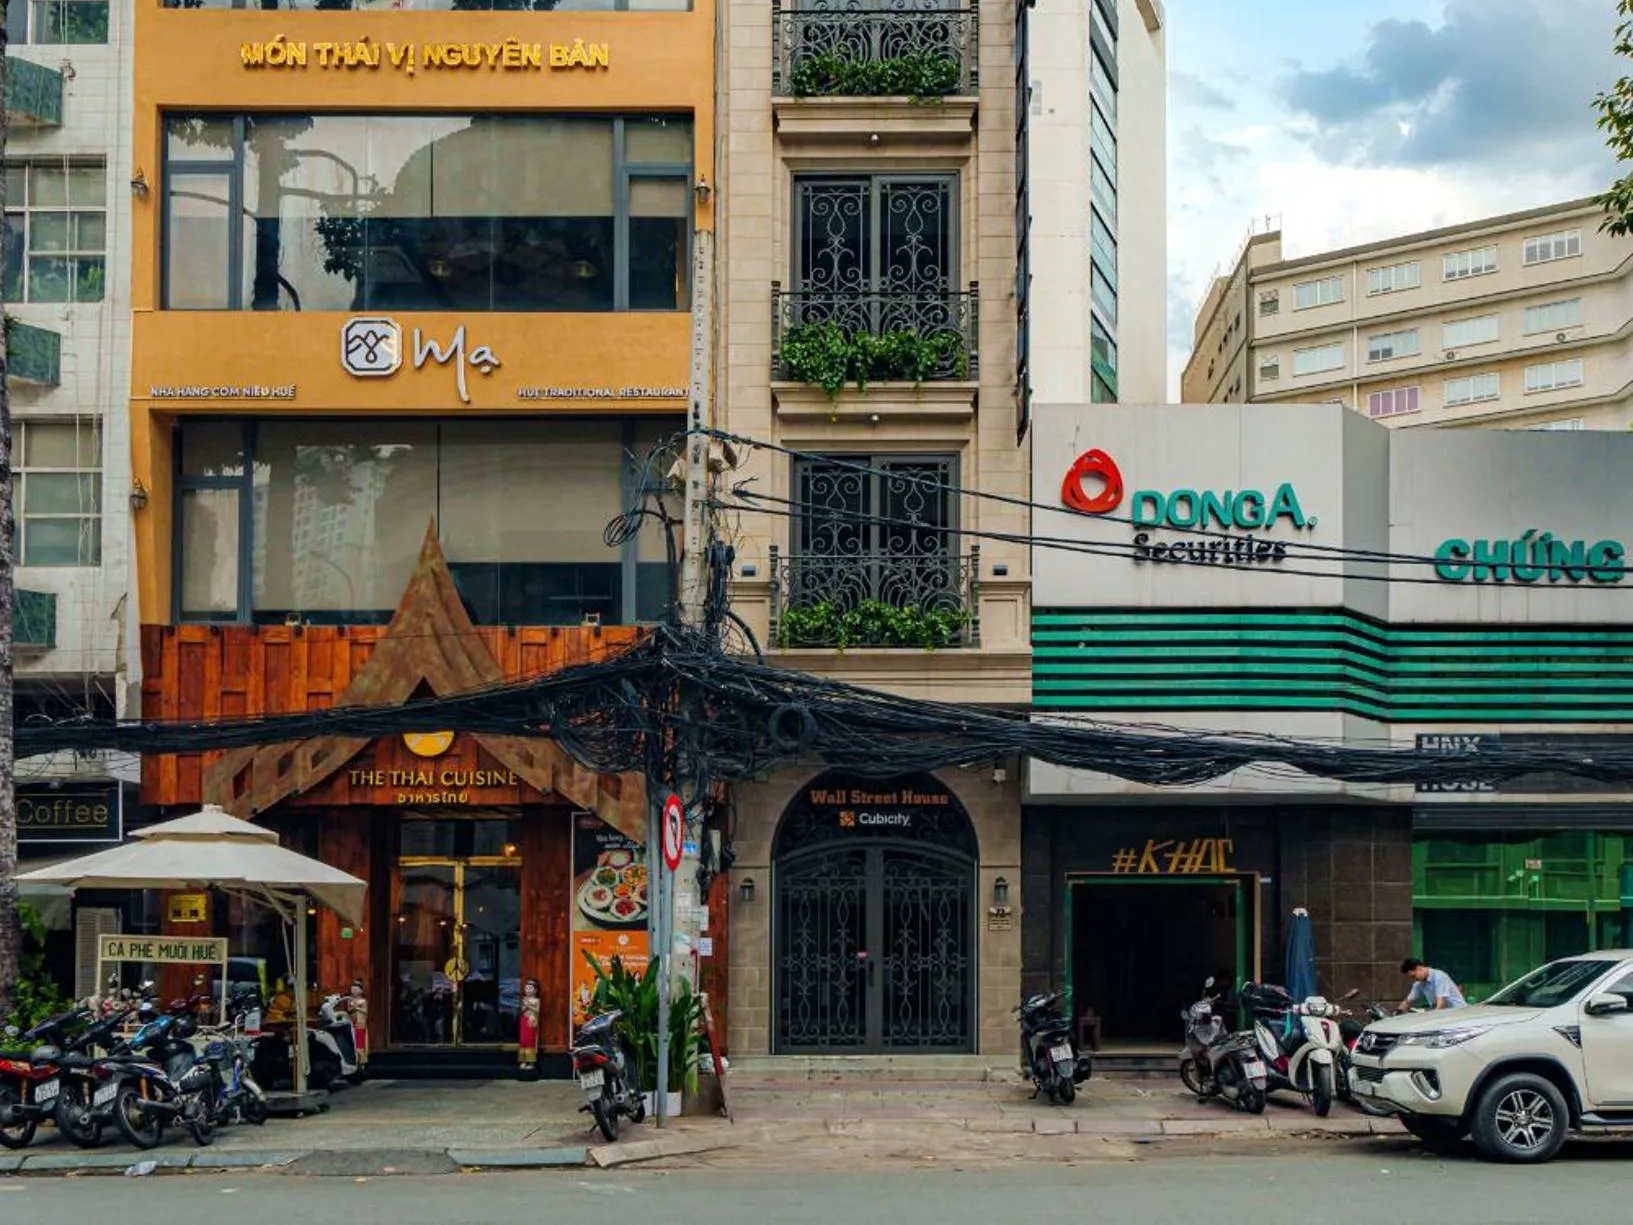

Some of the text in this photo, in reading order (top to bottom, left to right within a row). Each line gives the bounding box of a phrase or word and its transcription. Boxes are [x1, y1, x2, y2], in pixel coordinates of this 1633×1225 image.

[240, 34, 306, 66] MÓN
[313, 36, 380, 67] THÁI
[387, 42, 415, 75] VỊ
[423, 36, 541, 67] NGUYÊN
[1131, 481, 1306, 529] DONGA
[1133, 532, 1287, 564] Securities
[1434, 528, 1625, 583] CHỨNG
[350, 770, 518, 786] THE THAI CUISINE
[15, 798, 108, 824] Coffee
[810, 790, 949, 804] Wall Street House
[859, 812, 910, 827] Cubicity
